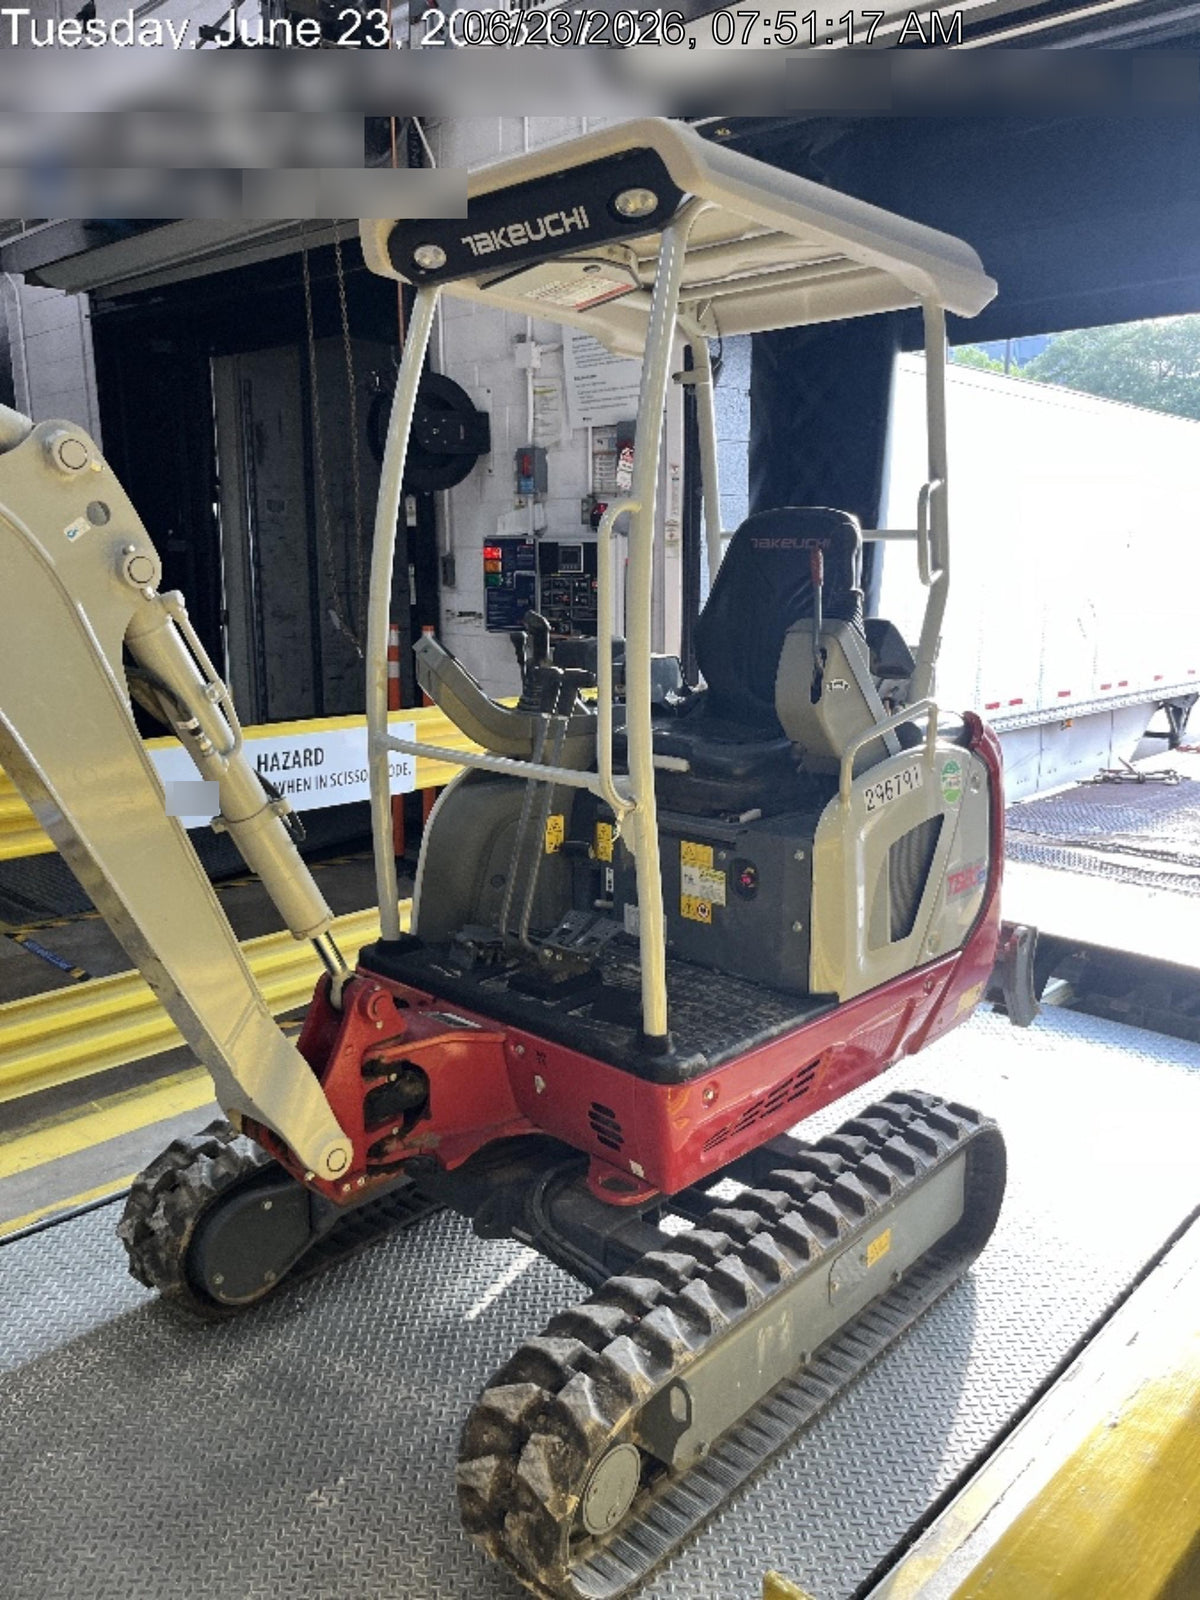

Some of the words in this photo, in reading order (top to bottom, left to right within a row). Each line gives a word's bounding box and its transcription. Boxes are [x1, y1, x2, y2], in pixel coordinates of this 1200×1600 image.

[460, 205, 590, 257] TAKEUCHI
[256, 747, 324, 773] HAZARD
[315, 776, 328, 789] IN
[330, 769, 369, 788] SCISSO
[389, 762, 412, 778] ODE.
